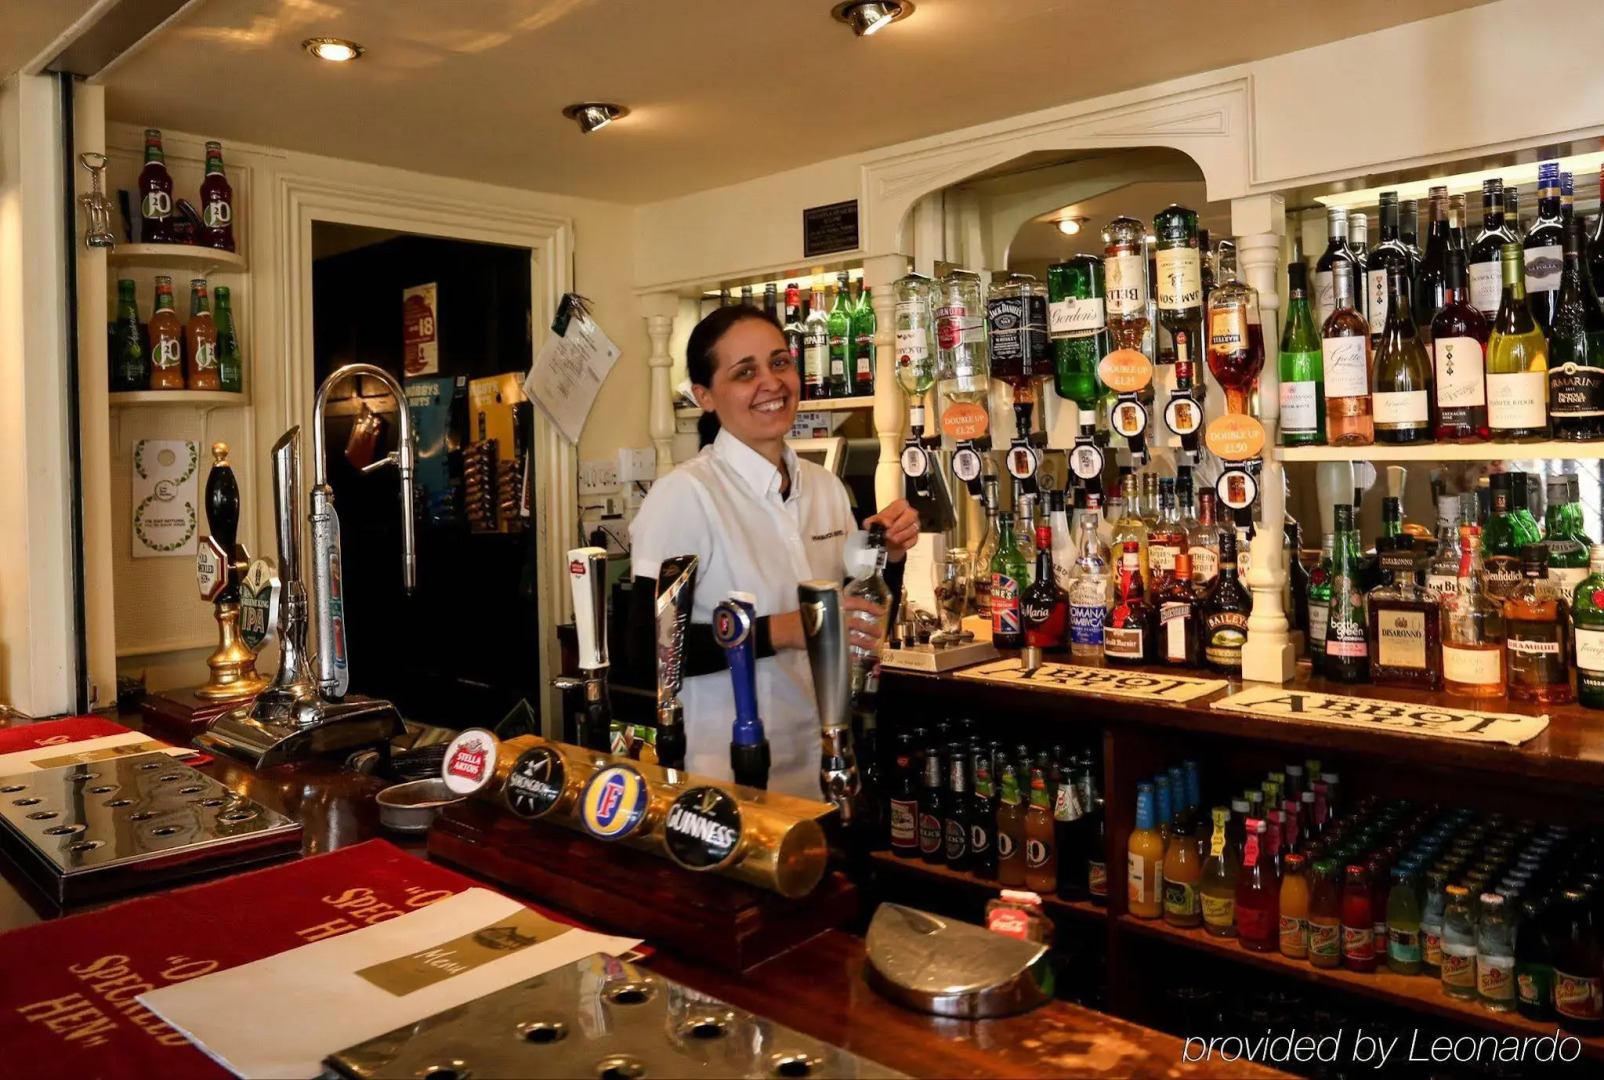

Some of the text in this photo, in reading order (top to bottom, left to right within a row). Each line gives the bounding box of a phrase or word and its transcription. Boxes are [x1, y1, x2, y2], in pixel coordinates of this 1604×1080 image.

[1159, 290, 1199, 304] JAMSO
[1051, 306, 1098, 327] Gordon's
[419, 316, 434, 337] 18
[944, 415, 985, 427] DOUBLE UP
[991, 588, 1012, 600] ONE'S
[1024, 604, 1049, 618] Maria
[1070, 607, 1106, 619] OMANA
[242, 607, 265, 633] IPA
[1208, 613, 1250, 628] BAILEYS
[1382, 629, 1422, 639] DISARONNO
[1240, 694, 1521, 734] ABBOT
[456, 752, 482, 766] STELLA
[453, 761, 480, 775] ARTOIS
[598, 783, 624, 817] F
[666, 804, 736, 848] GUINNESS
[322, 887, 405, 925] SPEC
[413, 948, 470, 975] Menu
